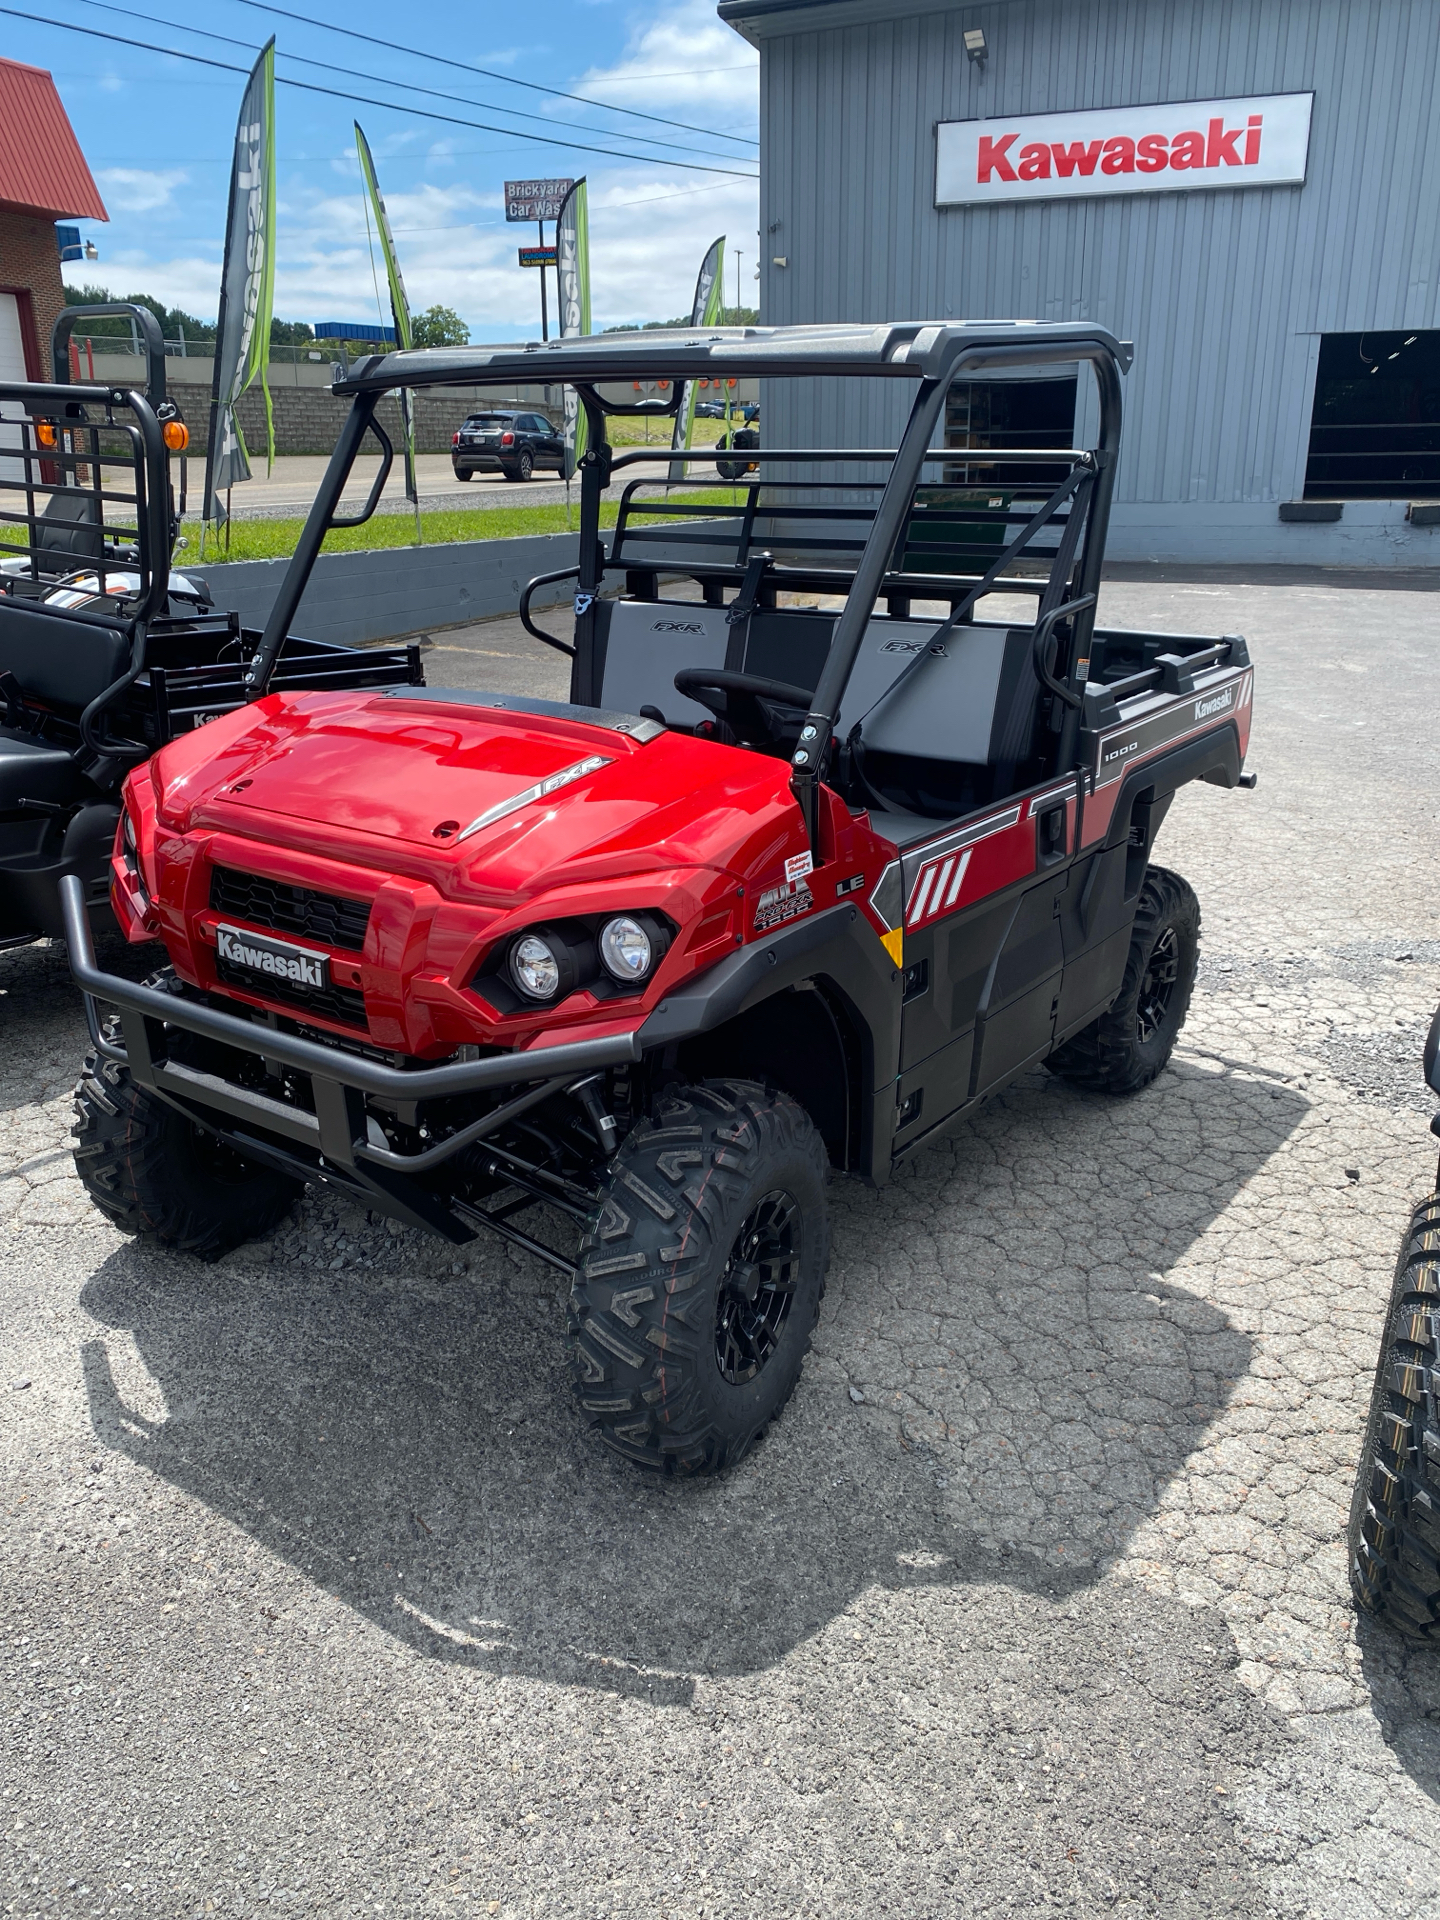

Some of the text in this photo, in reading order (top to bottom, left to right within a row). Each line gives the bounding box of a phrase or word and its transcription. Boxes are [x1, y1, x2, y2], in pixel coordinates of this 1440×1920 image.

[977, 114, 1263, 184] Kawasaki
[508, 182, 567, 197] Brickyard
[509, 200, 562, 216] Car Was
[650, 620, 705, 635] FXR
[880, 640, 948, 657] FXR
[1194, 688, 1232, 721] Kawasaki
[1105, 732, 1138, 762] 1000
[545, 757, 603, 793] FXR
[757, 877, 810, 911] MULE
[836, 874, 865, 897] LE
[217, 932, 322, 987] Kawasaki
[640, 1266, 675, 1280] DURO
